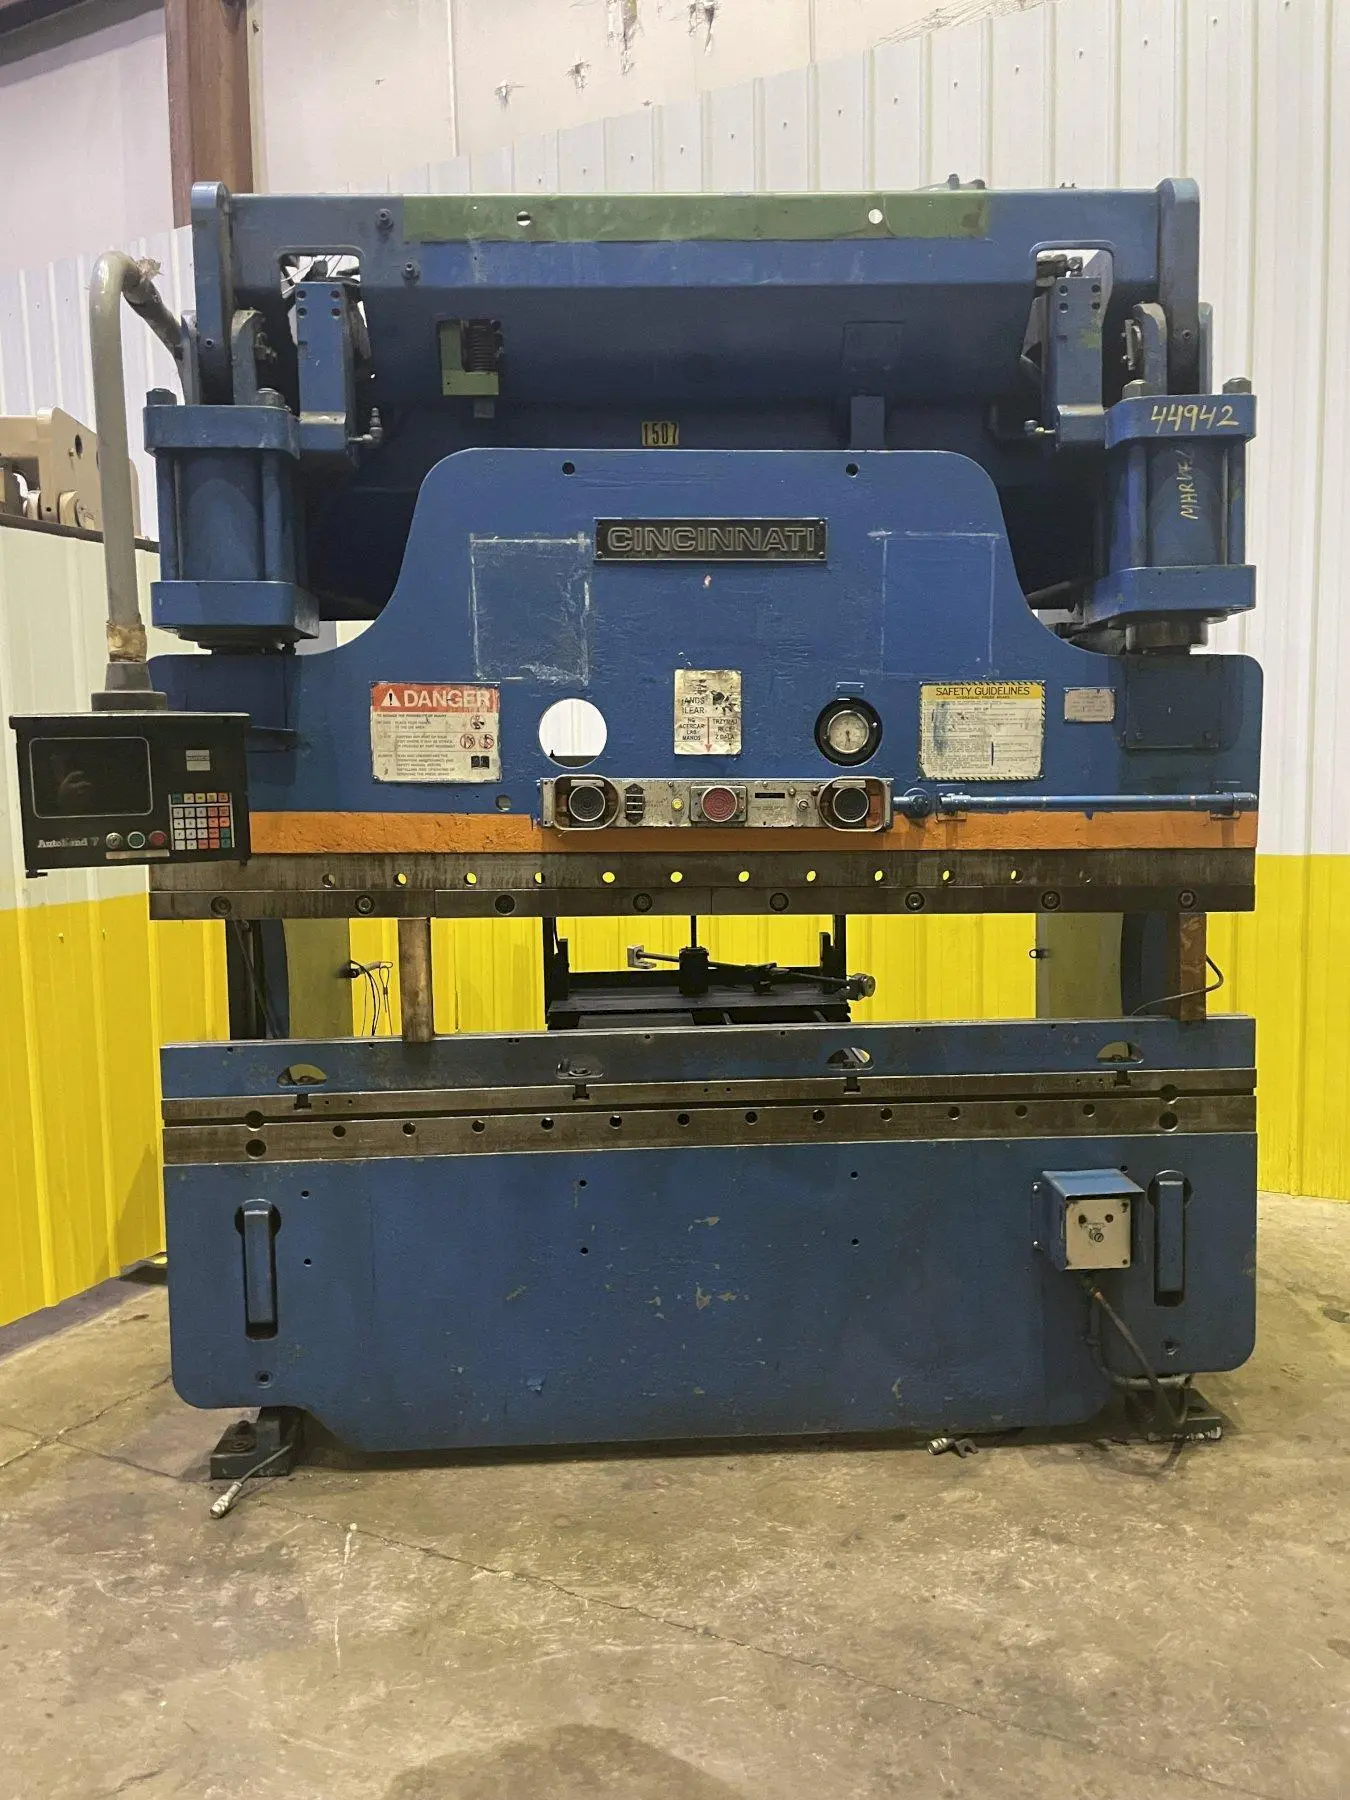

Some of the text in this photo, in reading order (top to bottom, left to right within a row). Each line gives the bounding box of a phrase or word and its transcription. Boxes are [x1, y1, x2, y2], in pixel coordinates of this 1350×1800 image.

[1150, 404, 1240, 433] 44942
[643, 422, 677, 445] 1507
[607, 527, 815, 551] CINCINNATI
[403, 689, 491, 708] DANGER
[935, 686, 1031, 696] SAFETY GUIDELINES
